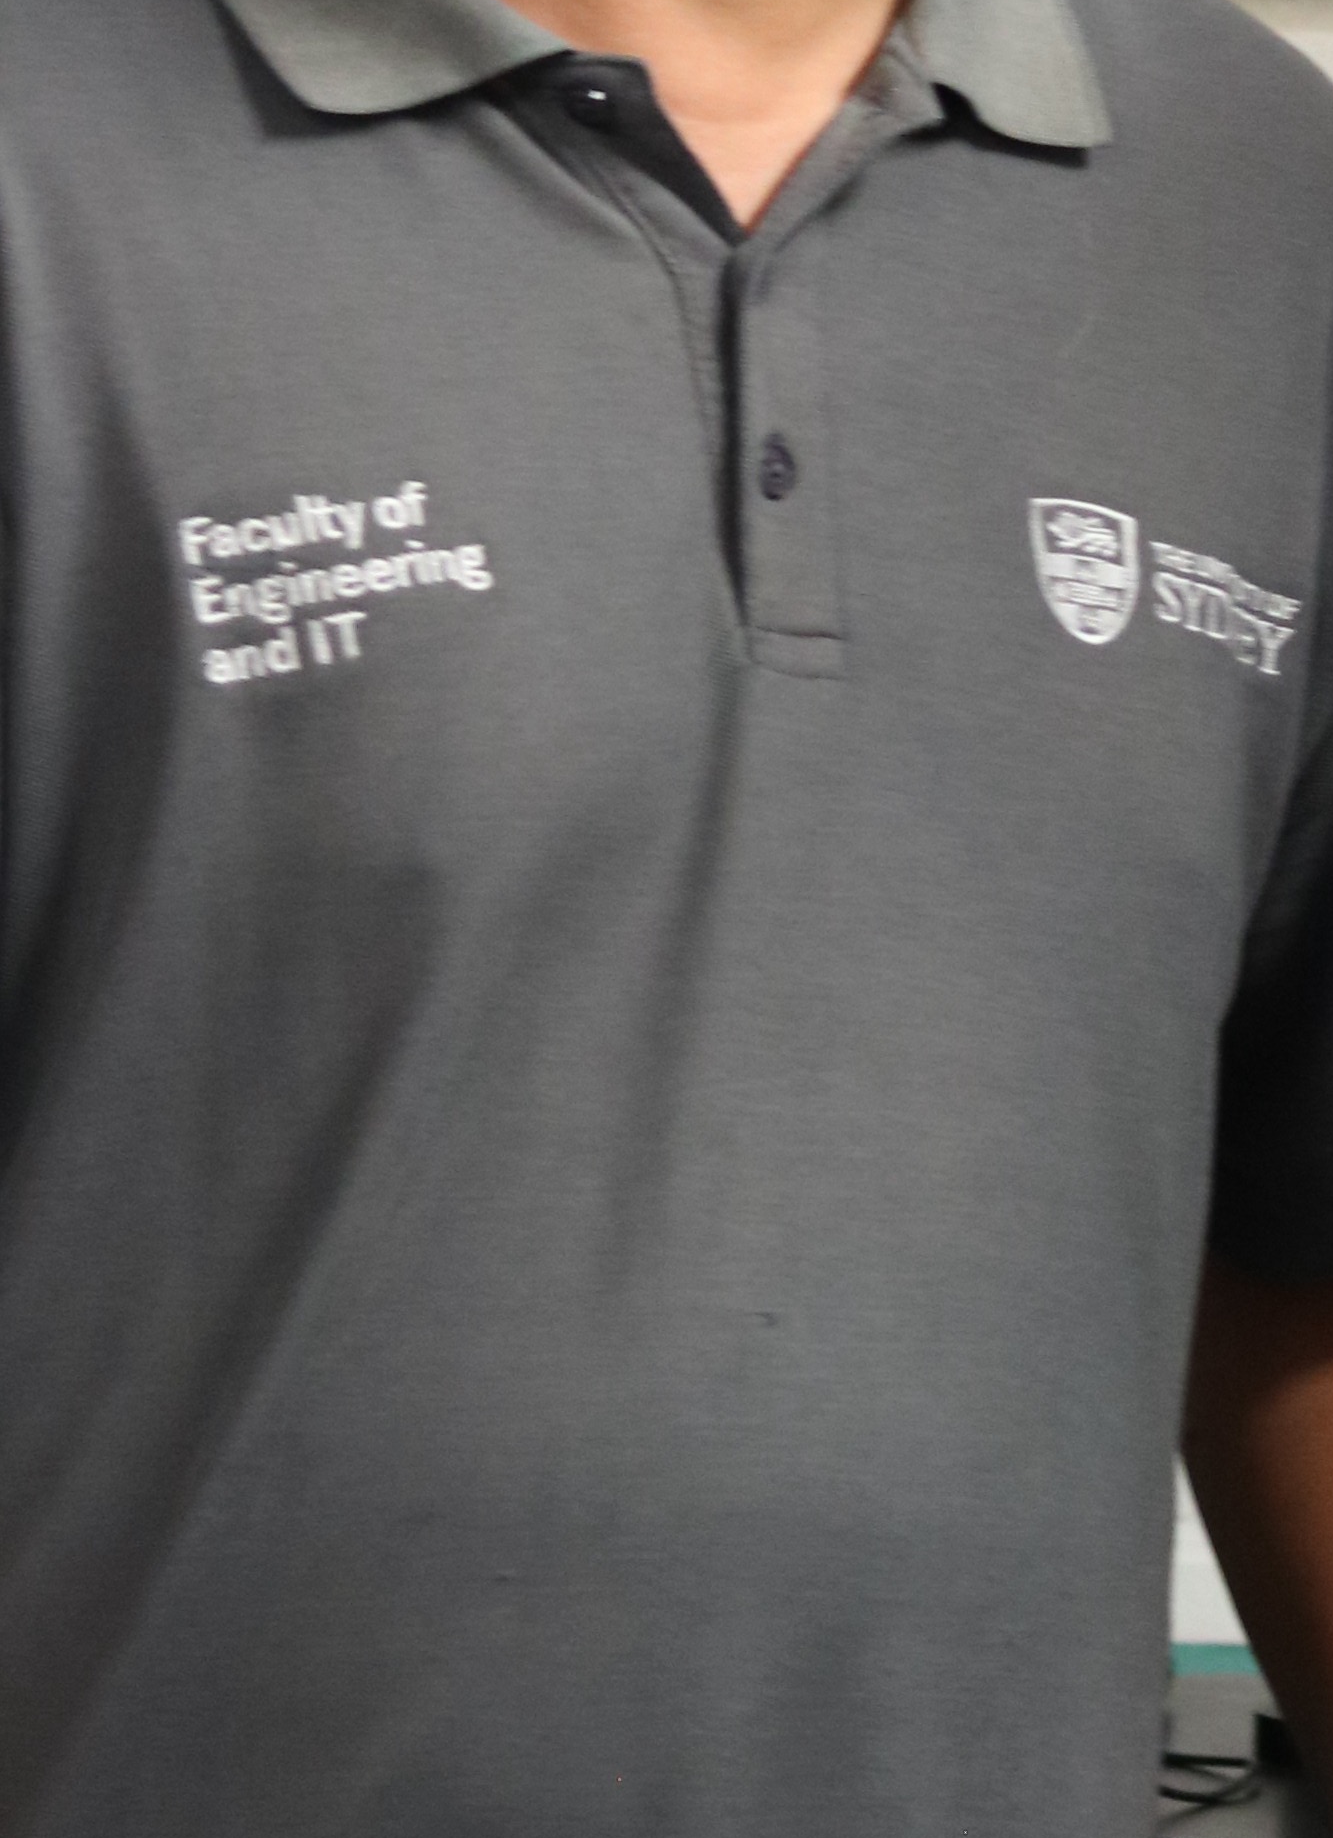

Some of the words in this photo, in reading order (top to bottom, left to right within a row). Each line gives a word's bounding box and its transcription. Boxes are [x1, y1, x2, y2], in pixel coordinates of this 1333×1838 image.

[177, 494, 366, 565] Faculty
[371, 480, 429, 529] of
[189, 539, 495, 625] Engineering
[202, 625, 302, 685] and
[306, 611, 367, 665] IT
